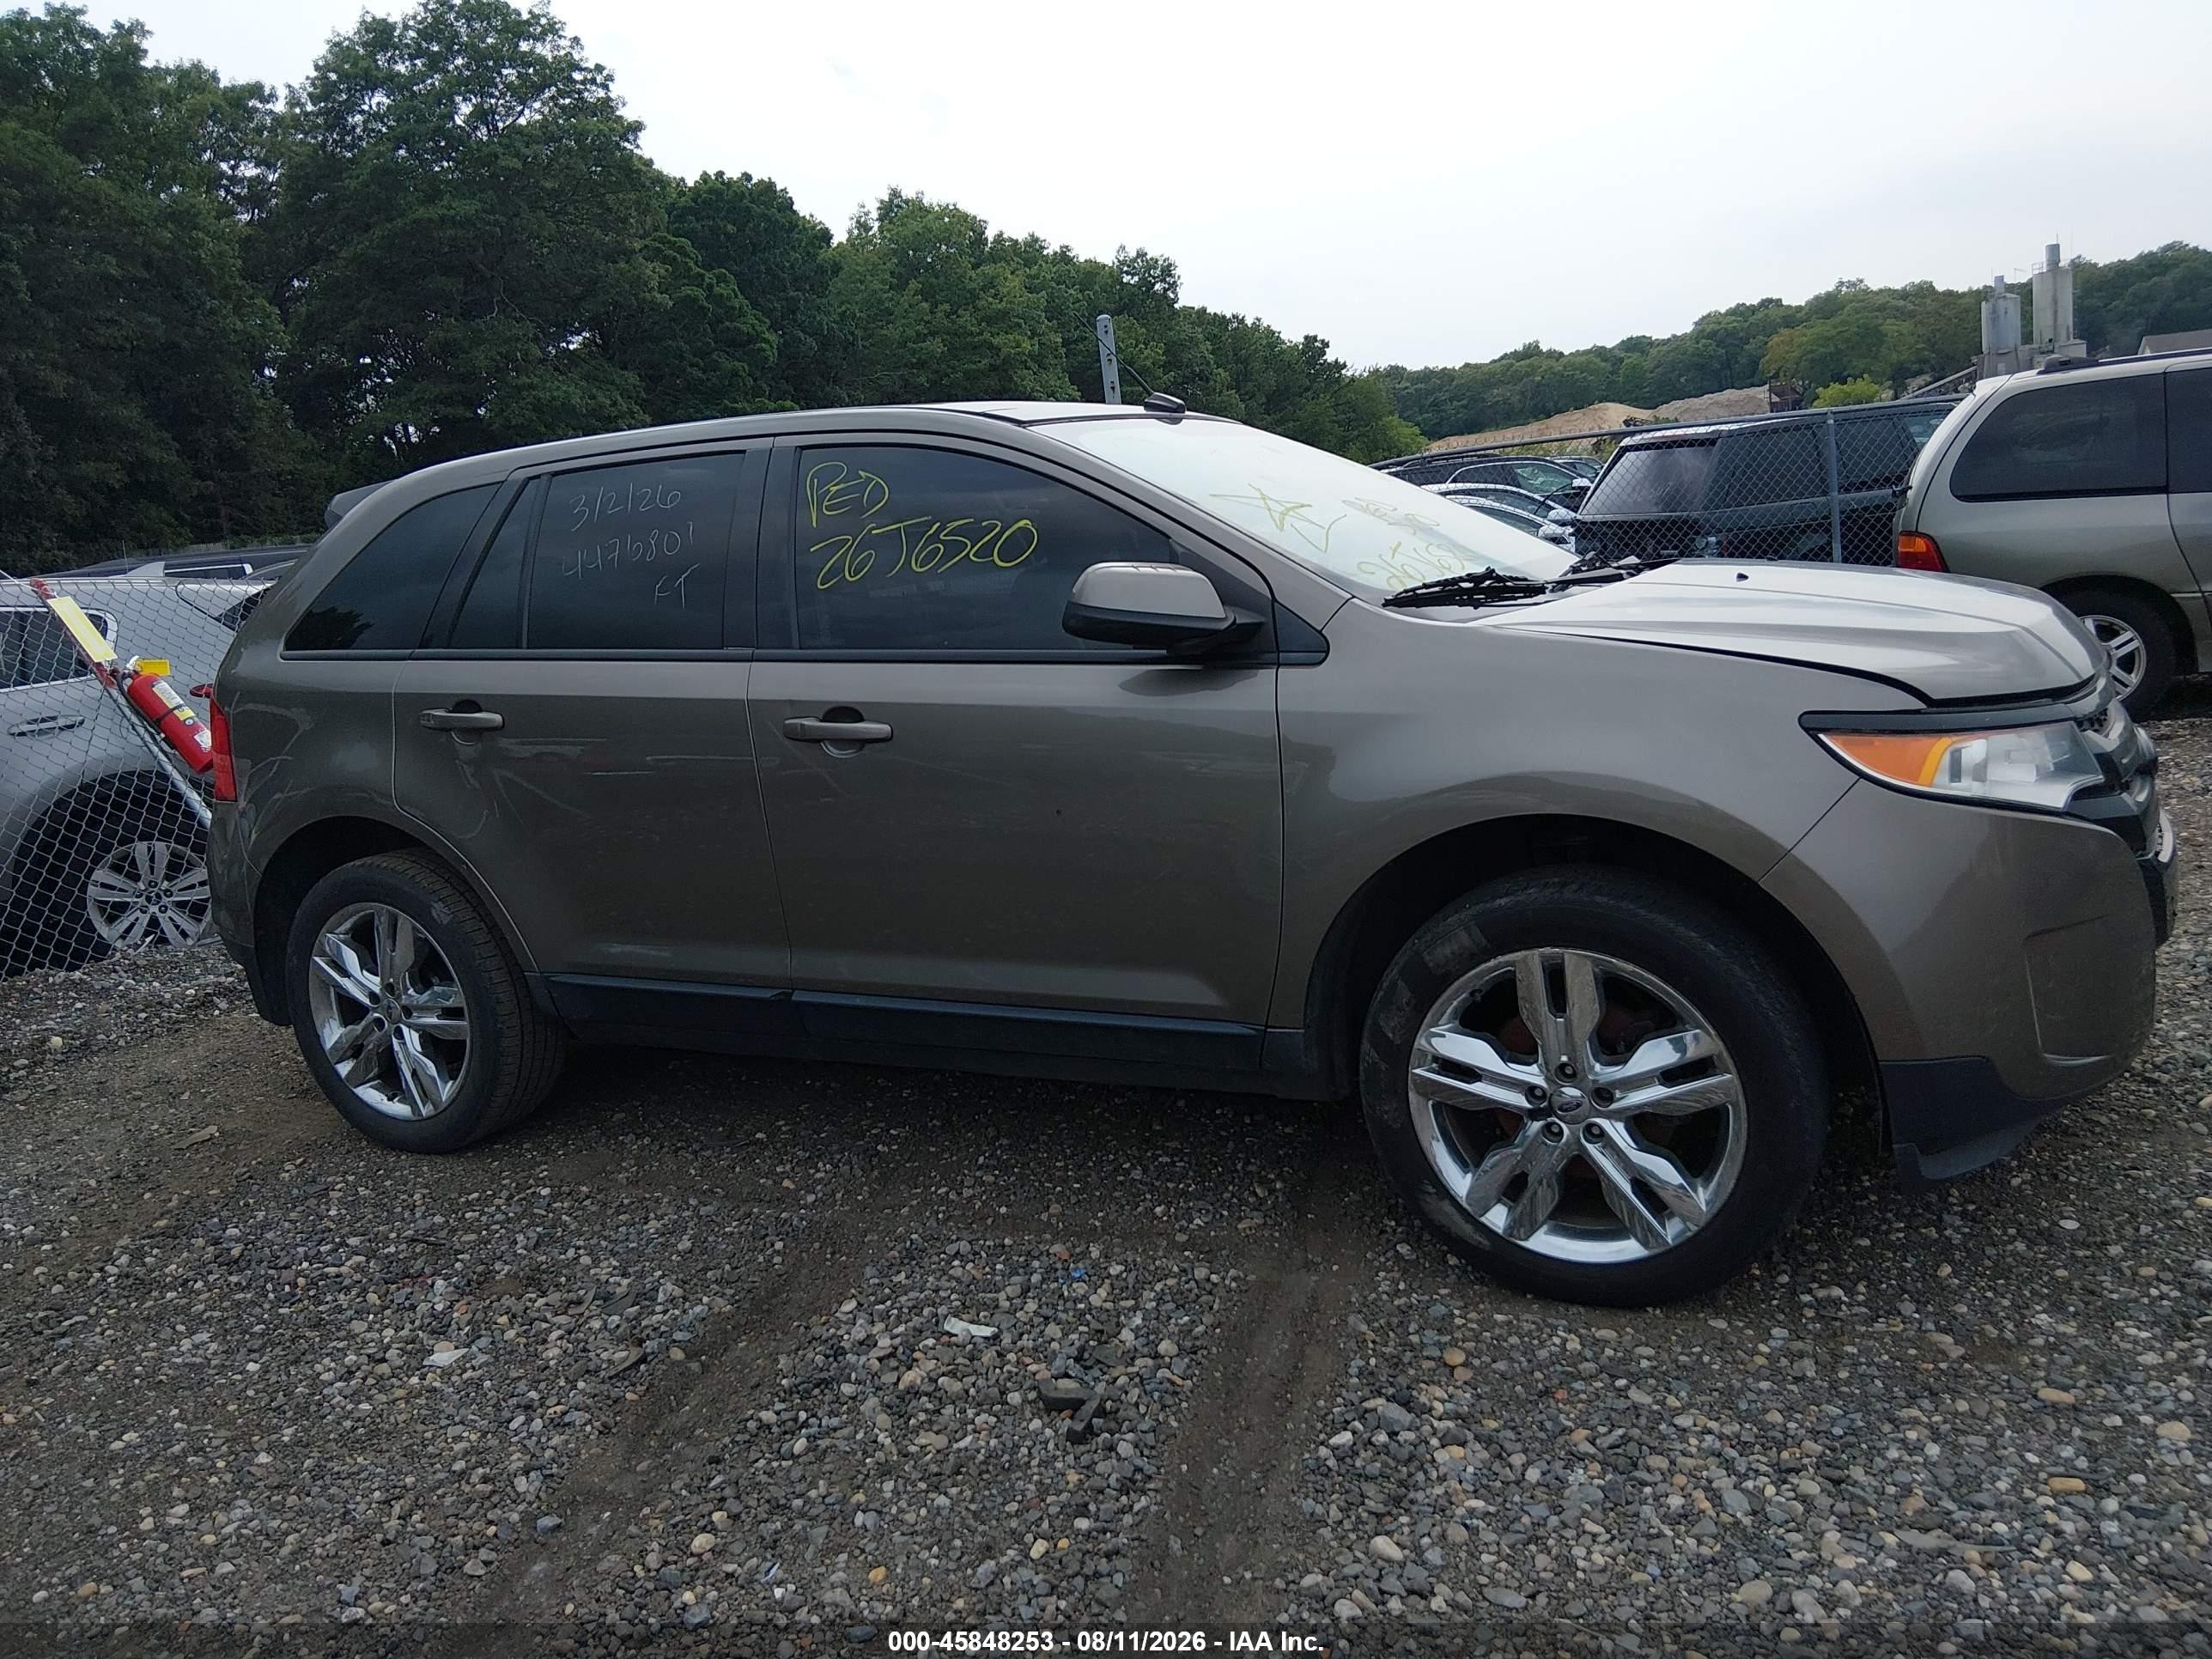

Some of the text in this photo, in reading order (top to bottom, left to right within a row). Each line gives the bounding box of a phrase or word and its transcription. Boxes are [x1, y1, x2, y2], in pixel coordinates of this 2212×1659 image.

[569, 483, 681, 532] 3/2/26
[805, 461, 890, 528] PED
[810, 515, 1038, 590] 26J6520
